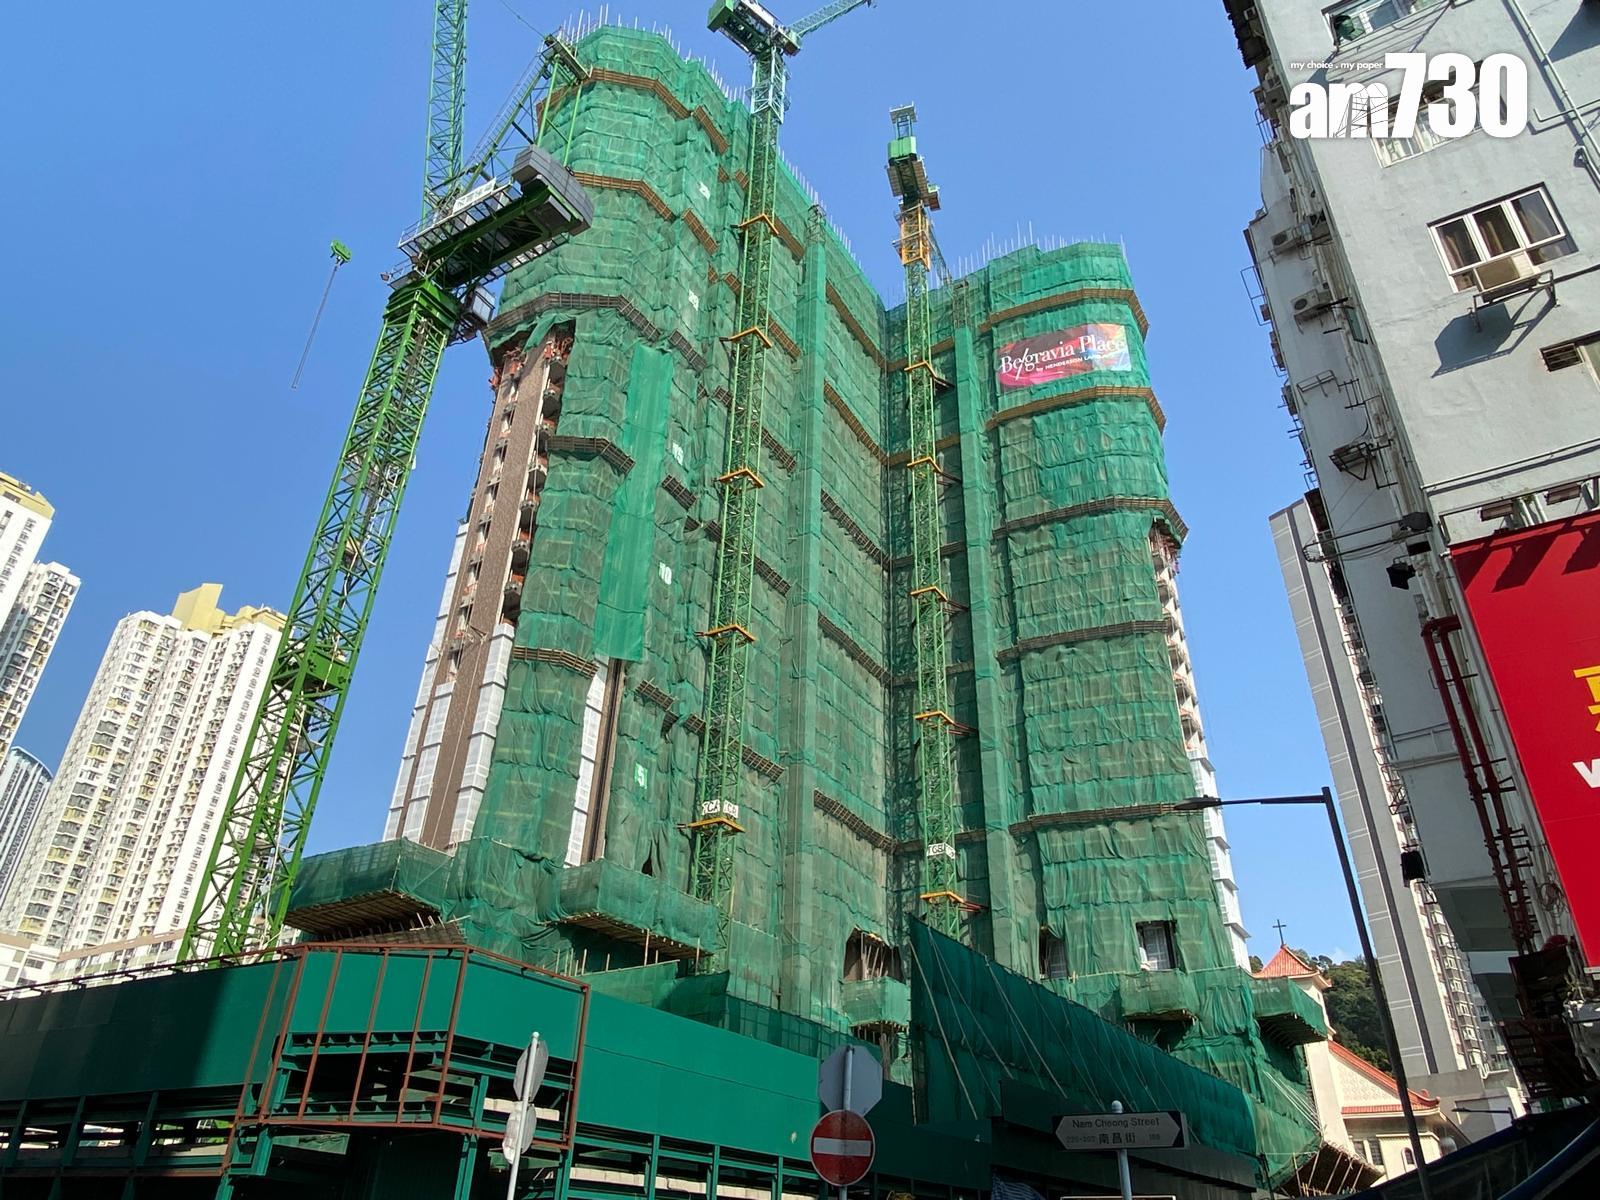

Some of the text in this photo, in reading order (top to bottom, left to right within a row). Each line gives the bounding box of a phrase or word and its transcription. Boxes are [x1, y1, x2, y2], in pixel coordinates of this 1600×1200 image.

[1000, 334, 1126, 381] Belgravia Place
[1045, 357, 1083, 370] HENDERSON
[1072, 1117, 1160, 1129] Nam Cheong Street
[1099, 1132, 1136, 1145] 南昌街
